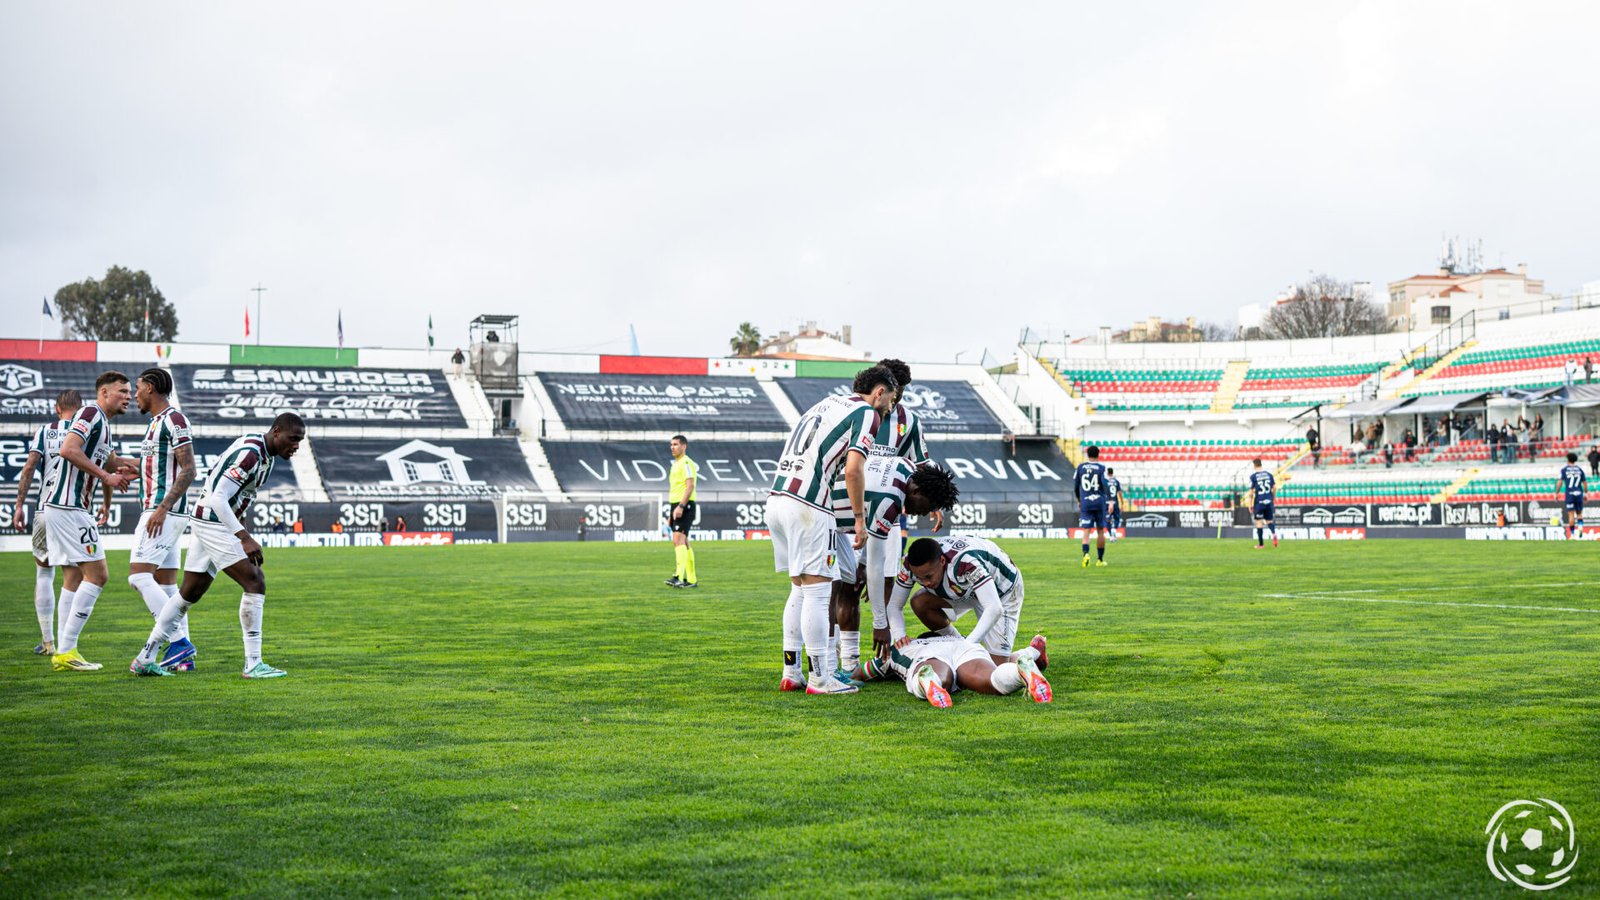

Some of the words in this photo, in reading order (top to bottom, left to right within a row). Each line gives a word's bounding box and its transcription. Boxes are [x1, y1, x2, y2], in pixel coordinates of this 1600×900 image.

[232, 370, 432, 385] SAMUROSA
[322, 384, 435, 394] Construção
[558, 384, 665, 396] NEUTRAL
[681, 386, 757, 397] PAPER
[220, 394, 292, 408] Juntos
[302, 397, 319, 409] a
[328, 395, 423, 410] Construir
[217, 408, 247, 418] O
[785, 414, 822, 456] 10
[1081, 473, 1100, 492] 64
[1110, 485, 1117, 498] 9
[1257, 479, 1271, 495] 35
[253, 503, 299, 527] 3SJ
[340, 503, 384, 526] 3SJ
[423, 503, 467, 526] 3SJ
[584, 503, 625, 527] 3SJ
[950, 503, 987, 525] 3SJ
[1018, 503, 1054, 525] 3SJ
[80, 526, 98, 544] 20
